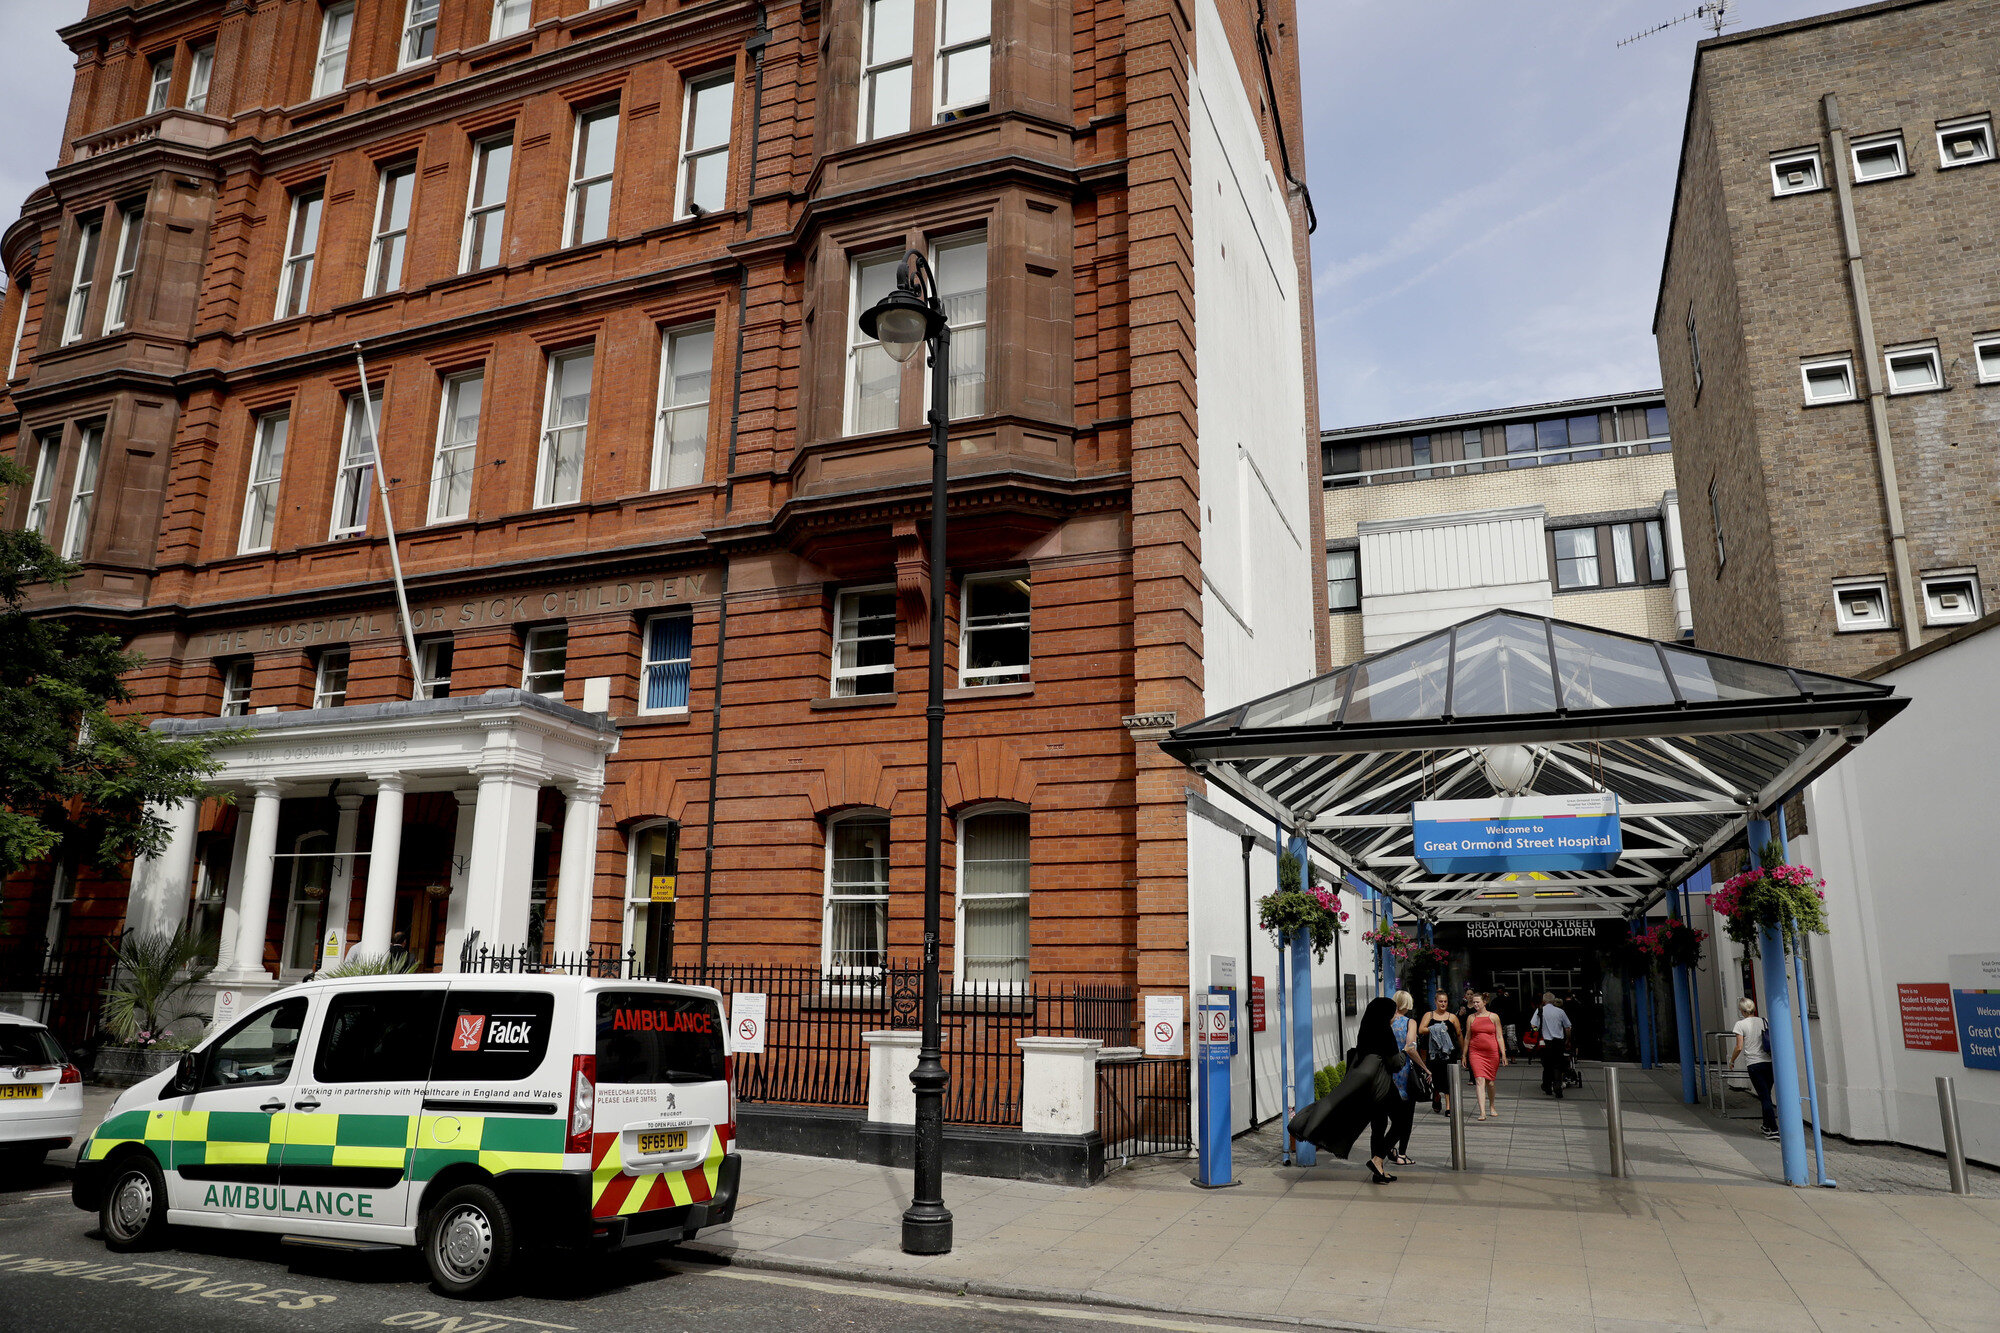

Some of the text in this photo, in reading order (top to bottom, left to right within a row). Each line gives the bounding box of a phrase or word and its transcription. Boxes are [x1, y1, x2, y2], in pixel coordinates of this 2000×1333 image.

[204, 574, 707, 652] THE HOSPITAL FOR SICK CHILDREN
[246, 740, 408, 763] PAUL O'GORMAN BUILDING
[1485, 825, 1544, 835] Welcome to
[1423, 835, 1611, 851] Great Ormond Street Hospital
[1466, 919, 1594, 930] GREAT ORMOND STREET
[1467, 927, 1596, 938] HOSPITAL FOR CHILDREN
[1924, 996, 1949, 1005] Emergency
[613, 1009, 712, 1034] AMBULANCE
[487, 1021, 532, 1044] Falck
[1968, 1025, 1993, 1038] Great
[1970, 1043, 1997, 1057] Street
[17, 1086, 37, 1097] HVW
[301, 1087, 563, 1099] Working in partnership with Healthcare in England and Wales
[642, 1133, 684, 1150] SF65 DYD
[204, 1184, 374, 1218] AMBULANCE
